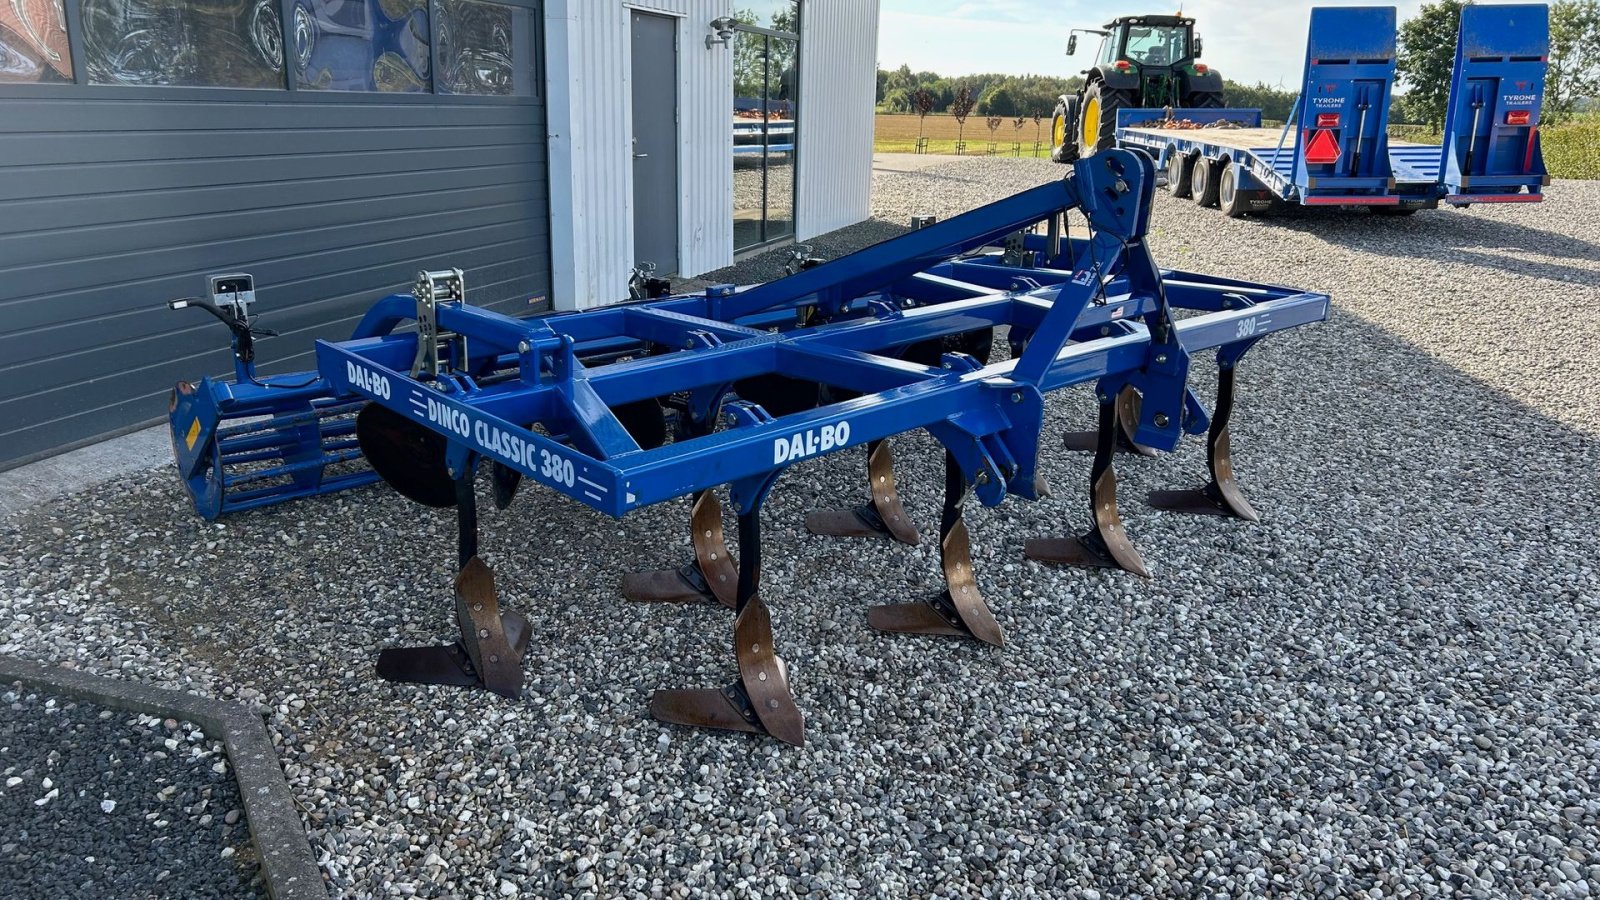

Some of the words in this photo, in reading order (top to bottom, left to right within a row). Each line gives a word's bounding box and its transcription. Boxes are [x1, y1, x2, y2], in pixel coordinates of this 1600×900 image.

[1236, 317, 1256, 338] 380
[427, 398, 470, 438] DINCO
[475, 420, 537, 472] CLASSIC
[540, 449, 575, 488] 380
